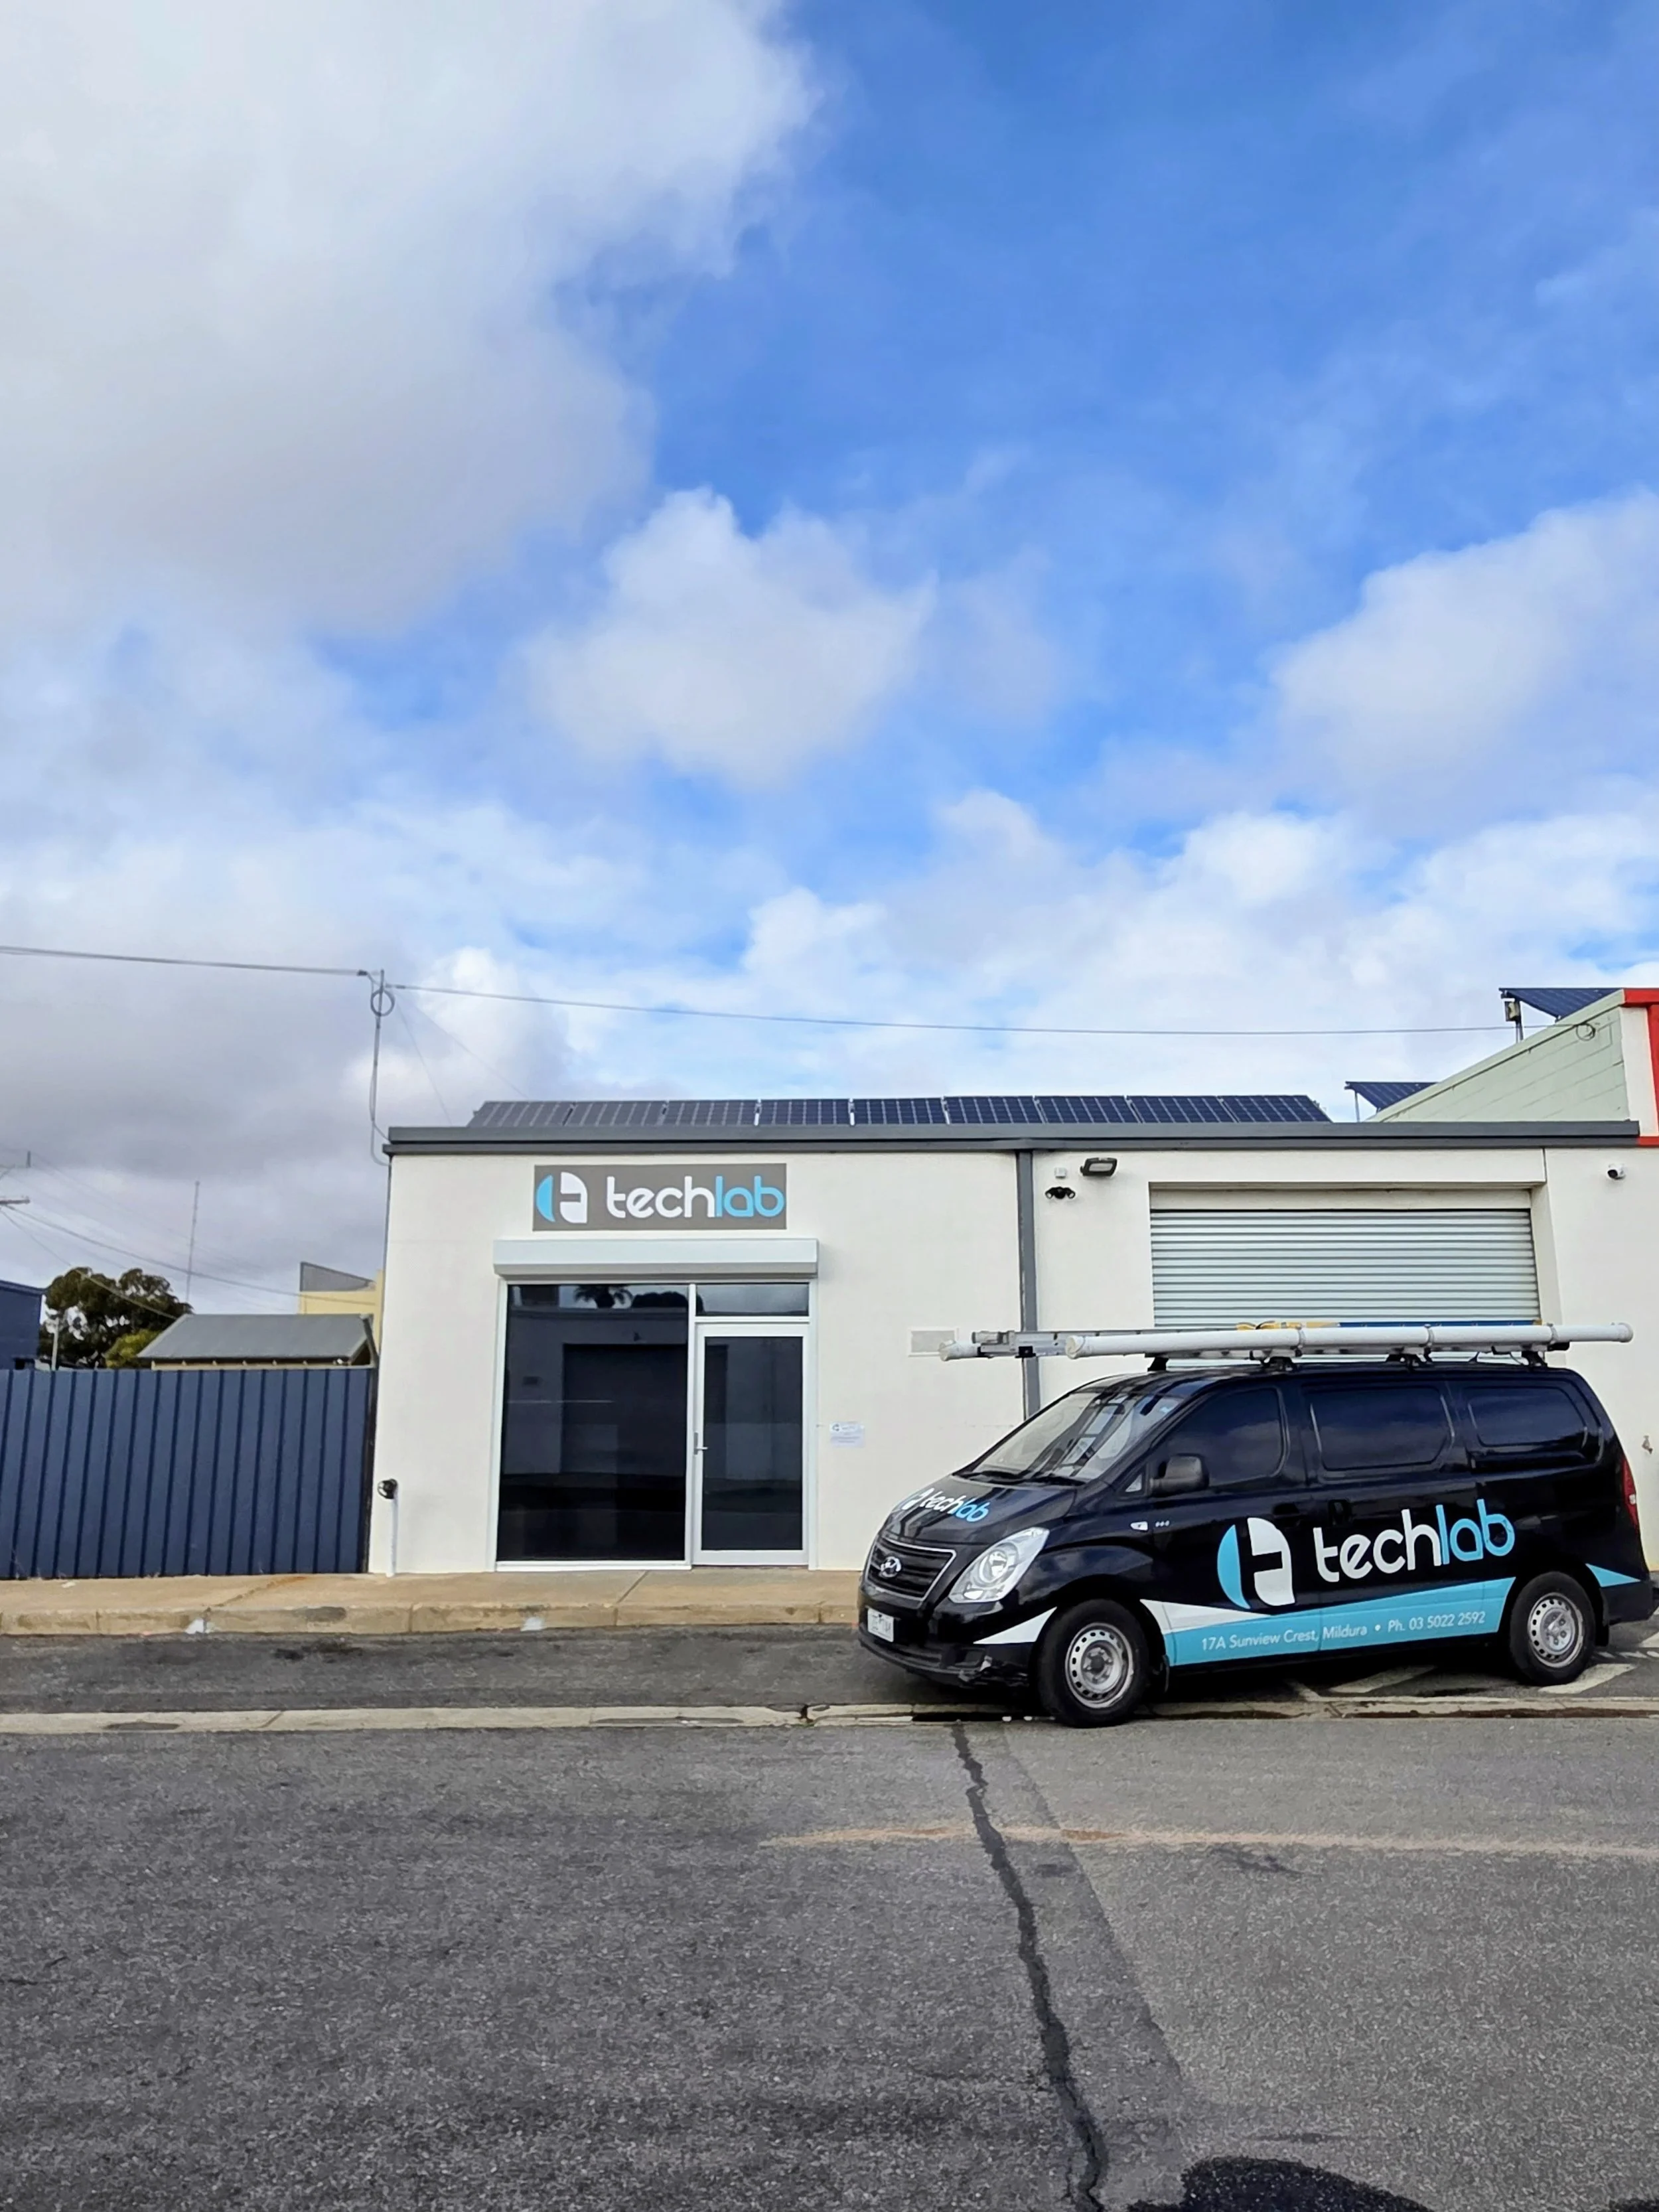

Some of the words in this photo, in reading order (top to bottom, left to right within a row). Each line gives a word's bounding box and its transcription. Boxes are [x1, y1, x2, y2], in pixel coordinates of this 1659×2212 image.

[607, 1175, 786, 1218] techlab
[920, 1491, 991, 1522] techlab
[1313, 1499, 1516, 1583] techlab
[1202, 1636, 1226, 1651] 17A
[1229, 1633, 1281, 1649] Sunview
[1323, 1623, 1368, 1640] Mildura
[1388, 1619, 1406, 1633] Ph.
[1409, 1617, 1423, 1631] 03
[1427, 1613, 1455, 1629] 5022
[1458, 1611, 1486, 1626] 2592
